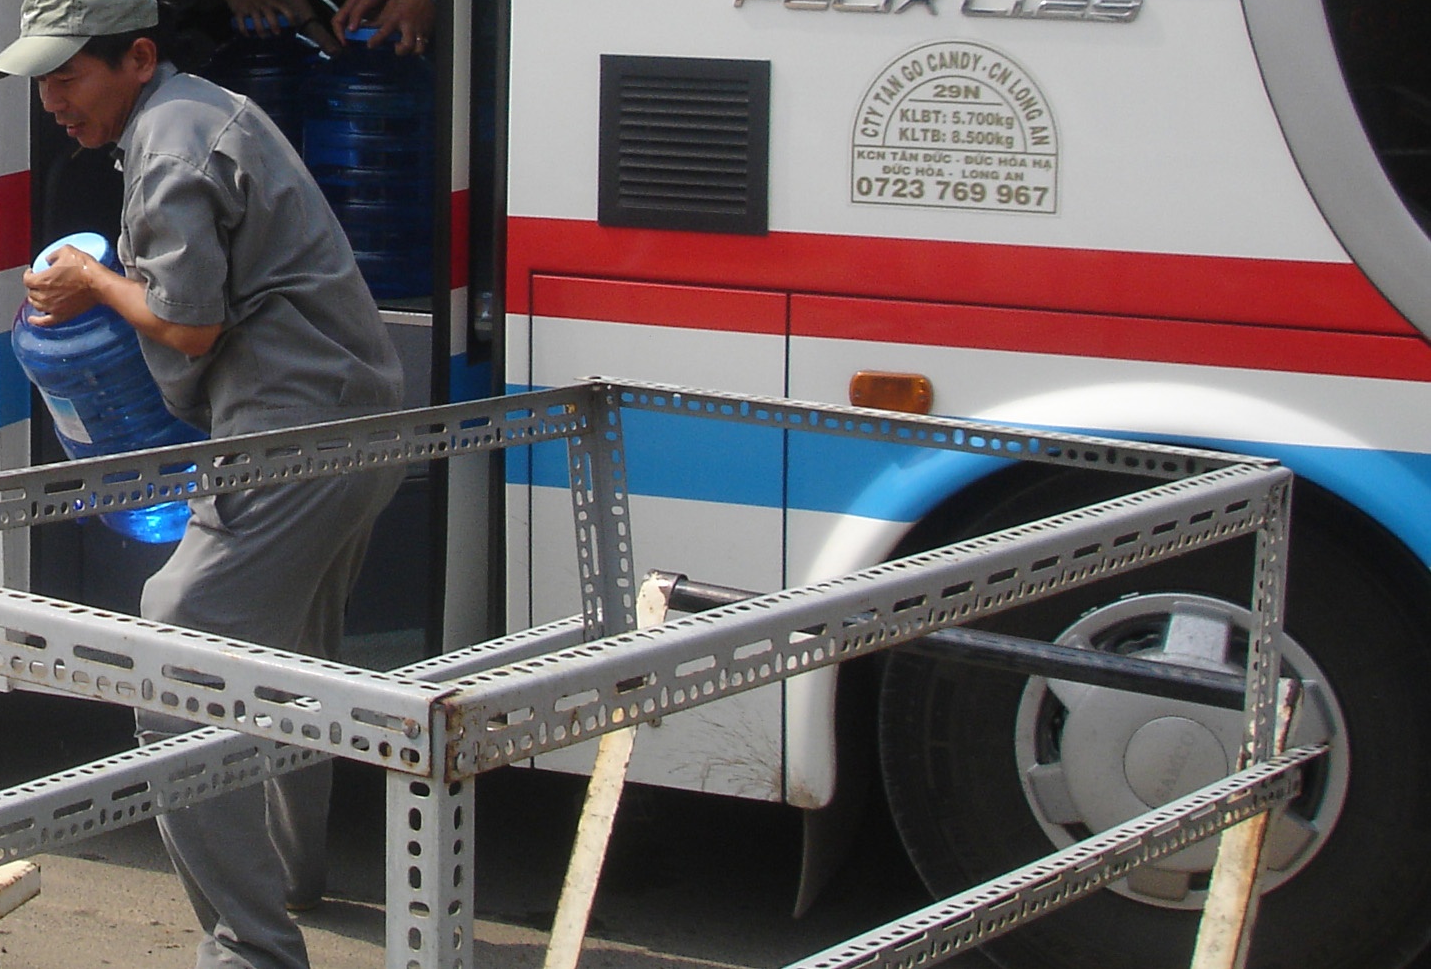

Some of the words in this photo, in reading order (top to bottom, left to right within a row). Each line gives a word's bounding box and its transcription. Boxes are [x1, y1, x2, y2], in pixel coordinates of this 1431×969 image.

[860, 106, 884, 138] CTY
[873, 75, 904, 106] TAN
[901, 59, 924, 82] GO
[926, 50, 982, 73] CANDY
[988, 62, 1013, 86] CN
[1008, 78, 1044, 122] LONG
[1029, 126, 1050, 146] AN
[932, 84, 981, 99] 29N
[899, 108, 947, 125] KLBT:
[952, 111, 1015, 130] 5.700kg
[898, 127, 947, 143] KLTB:
[952, 130, 1015, 149] 8.500kg
[857, 149, 886, 161] KCN
[890, 148, 918, 162] TÂN
[961, 169, 1000, 181] LONG
[1004, 171, 1025, 182] AN
[856, 176, 925, 200] 0723
[935, 180, 987, 203] 769
[996, 184, 1049, 207] 967
